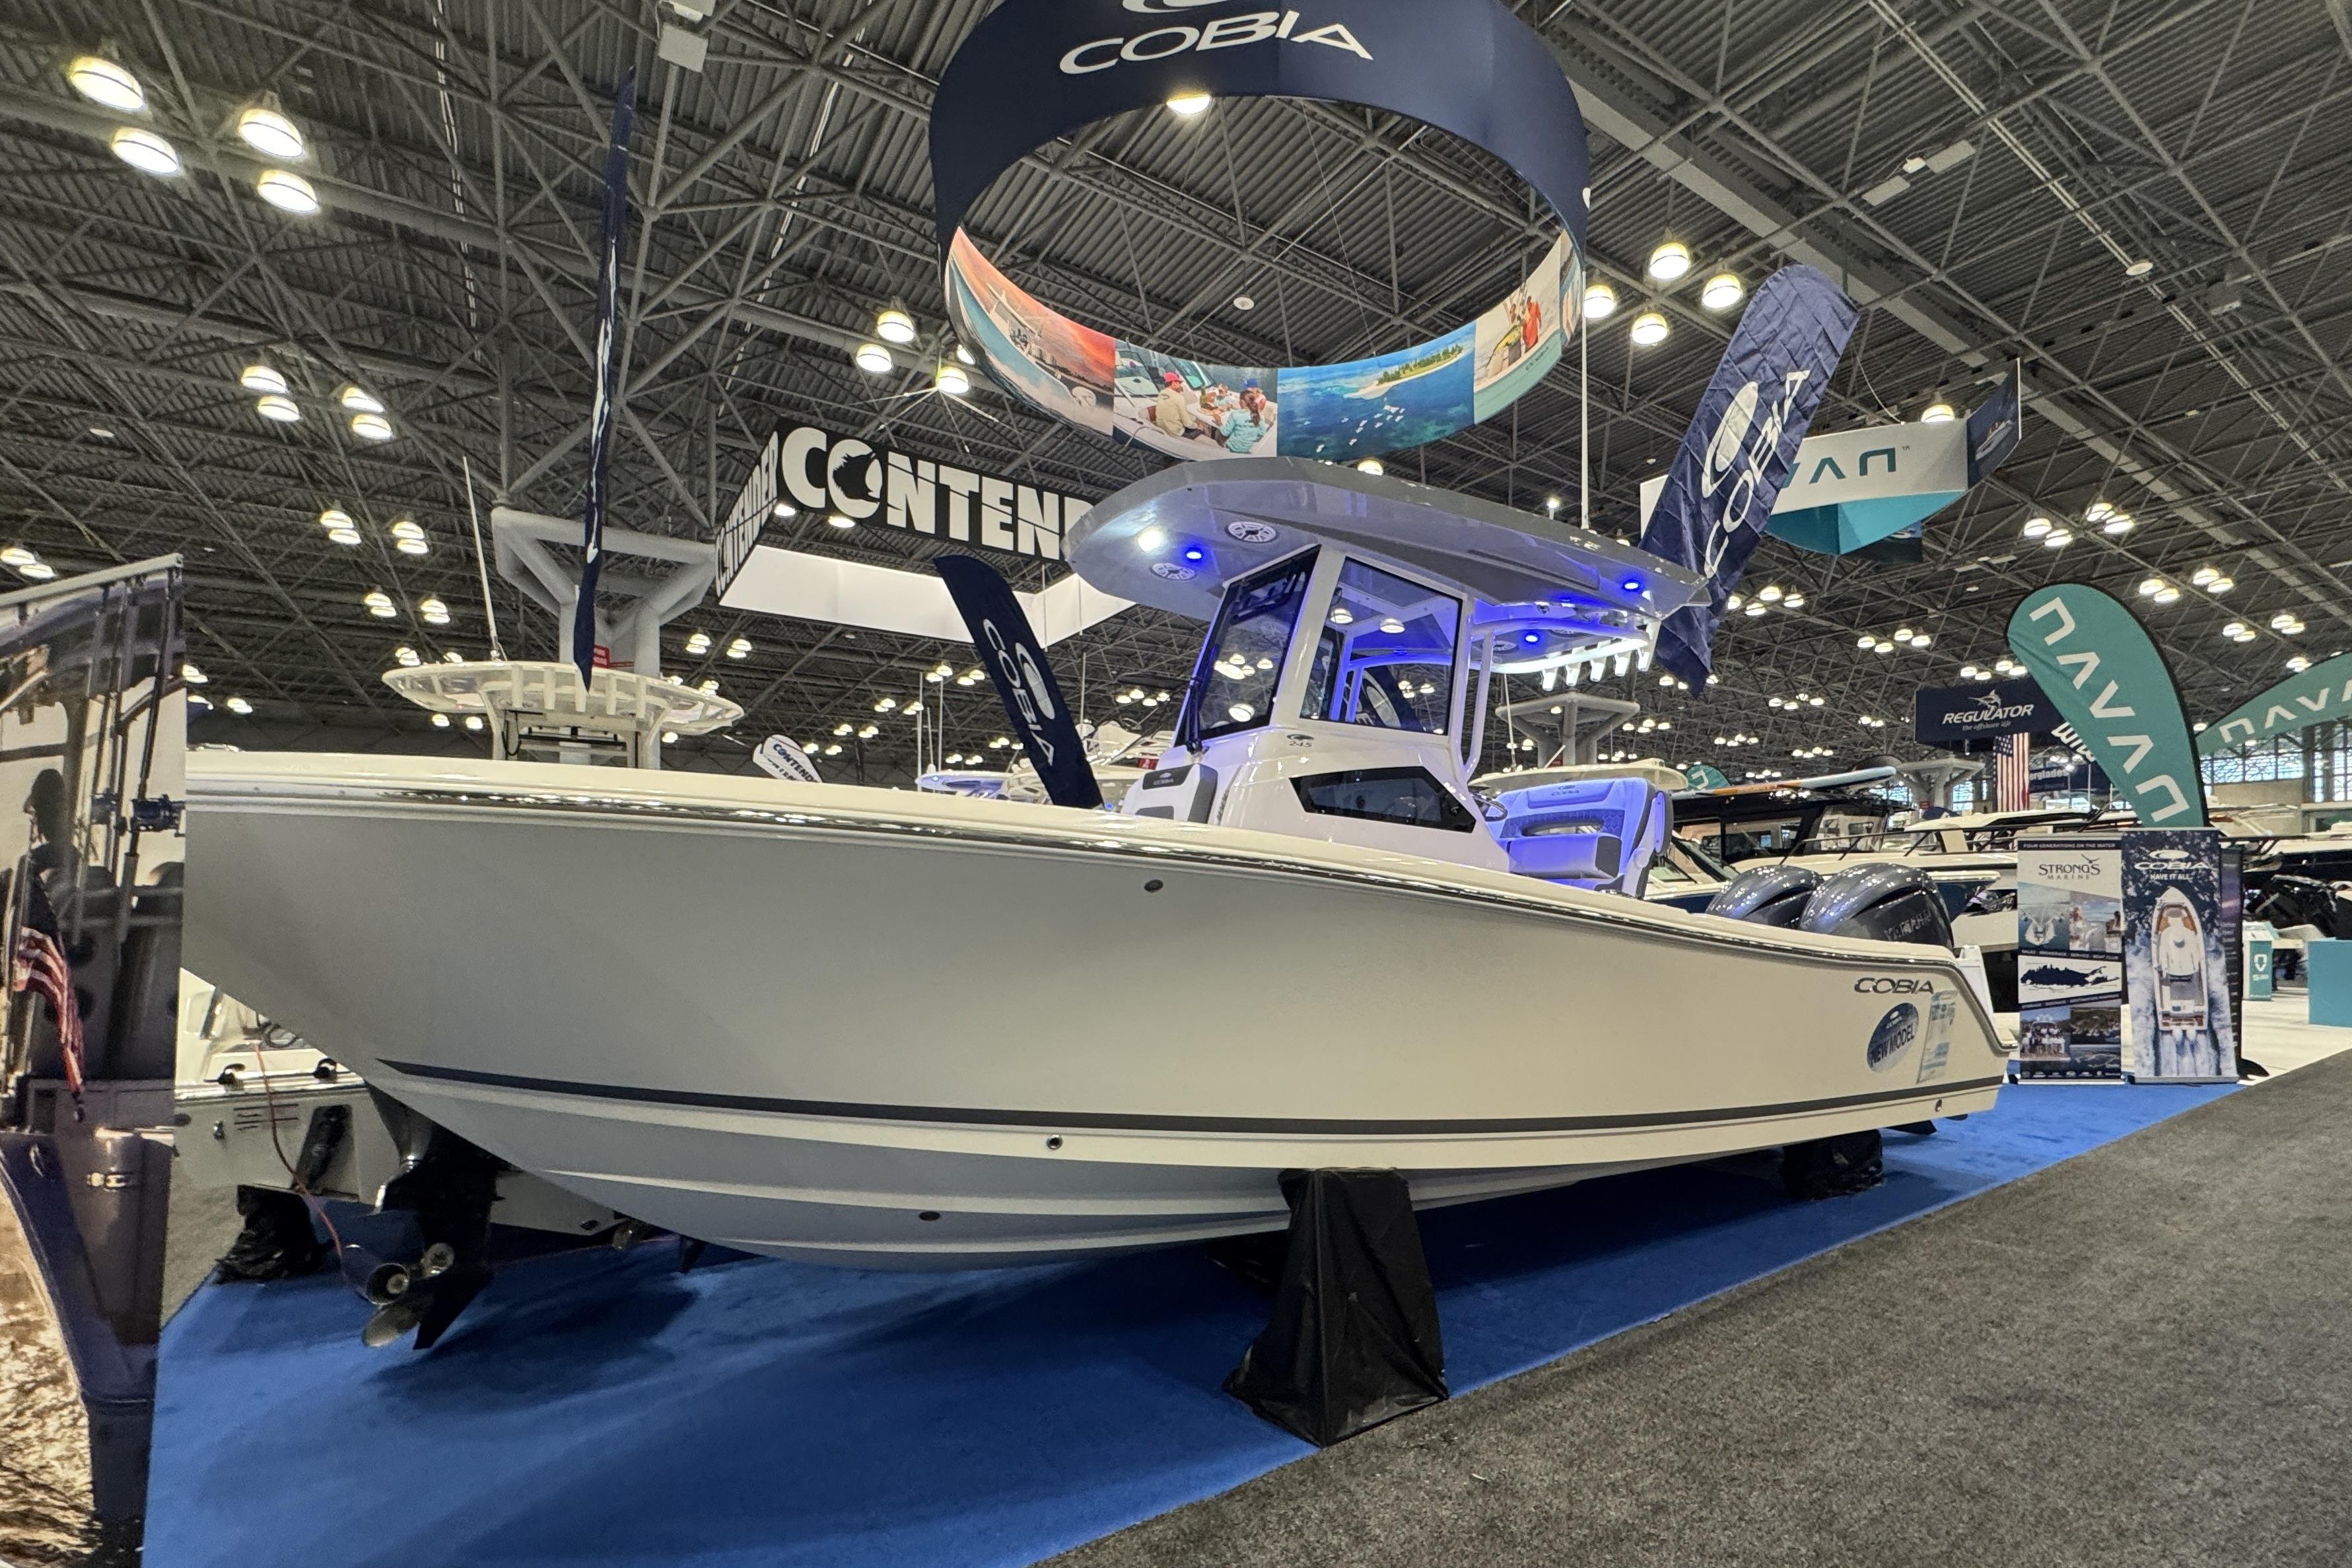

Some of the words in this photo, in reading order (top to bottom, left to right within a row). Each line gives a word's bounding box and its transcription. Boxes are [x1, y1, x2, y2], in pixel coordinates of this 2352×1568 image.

[1058, 10, 1373, 75] COBIA
[1704, 370, 1810, 578] COBIA
[983, 619, 1055, 767] COBIA
[1942, 704, 2034, 724] REGULATOR
[2133, 862, 2210, 870] COBIA
[1854, 977, 1934, 994] COBIA
[1888, 1023, 1915, 1054] MODEL
